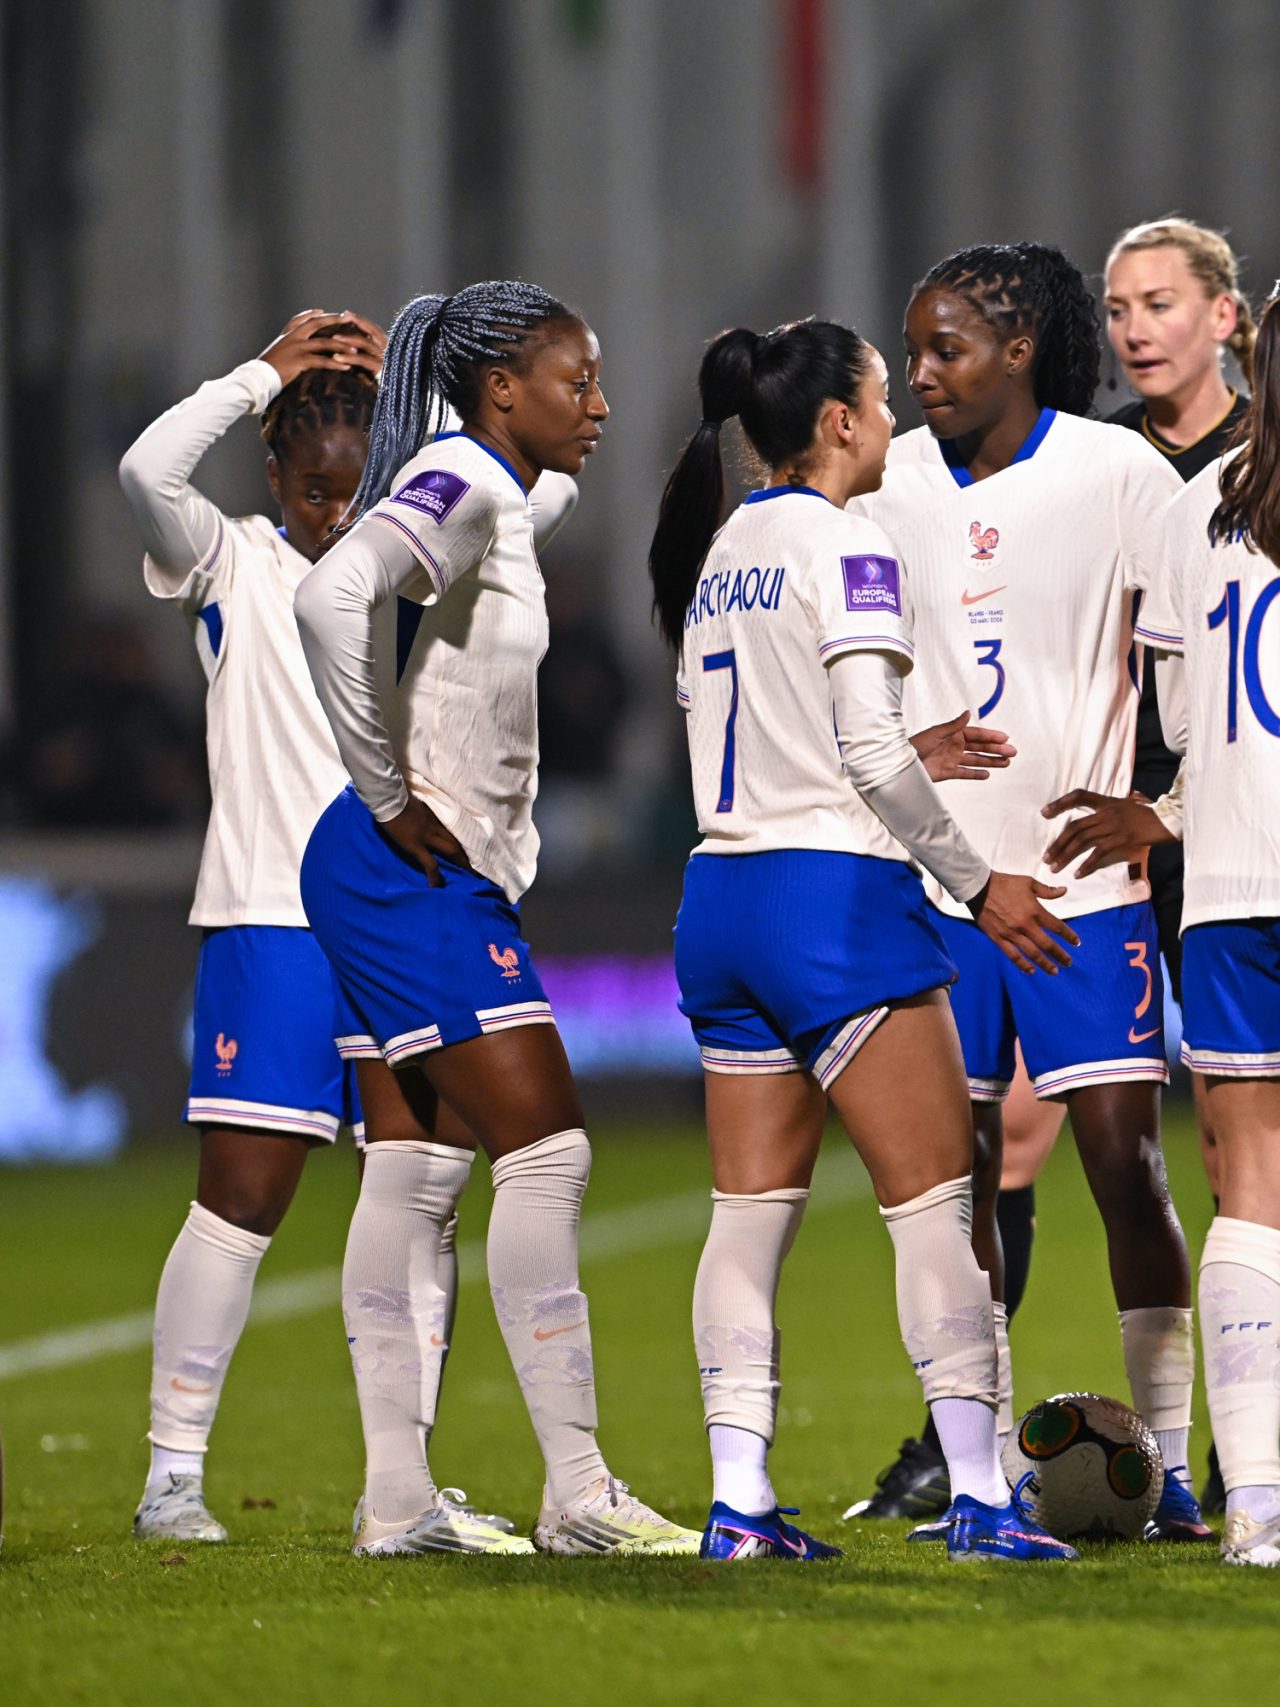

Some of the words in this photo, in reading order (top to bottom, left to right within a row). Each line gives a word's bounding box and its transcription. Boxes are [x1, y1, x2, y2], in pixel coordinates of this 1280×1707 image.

[399, 493, 444, 515] QUALIFIERS
[403, 489, 446, 509] EUROPEAN
[852, 589, 895, 600] EUROPEAN
[852, 596, 897, 607] QUALIFIERS
[973, 638, 1006, 721] 3
[702, 648, 737, 814] 7
[1124, 942, 1153, 1020] 3
